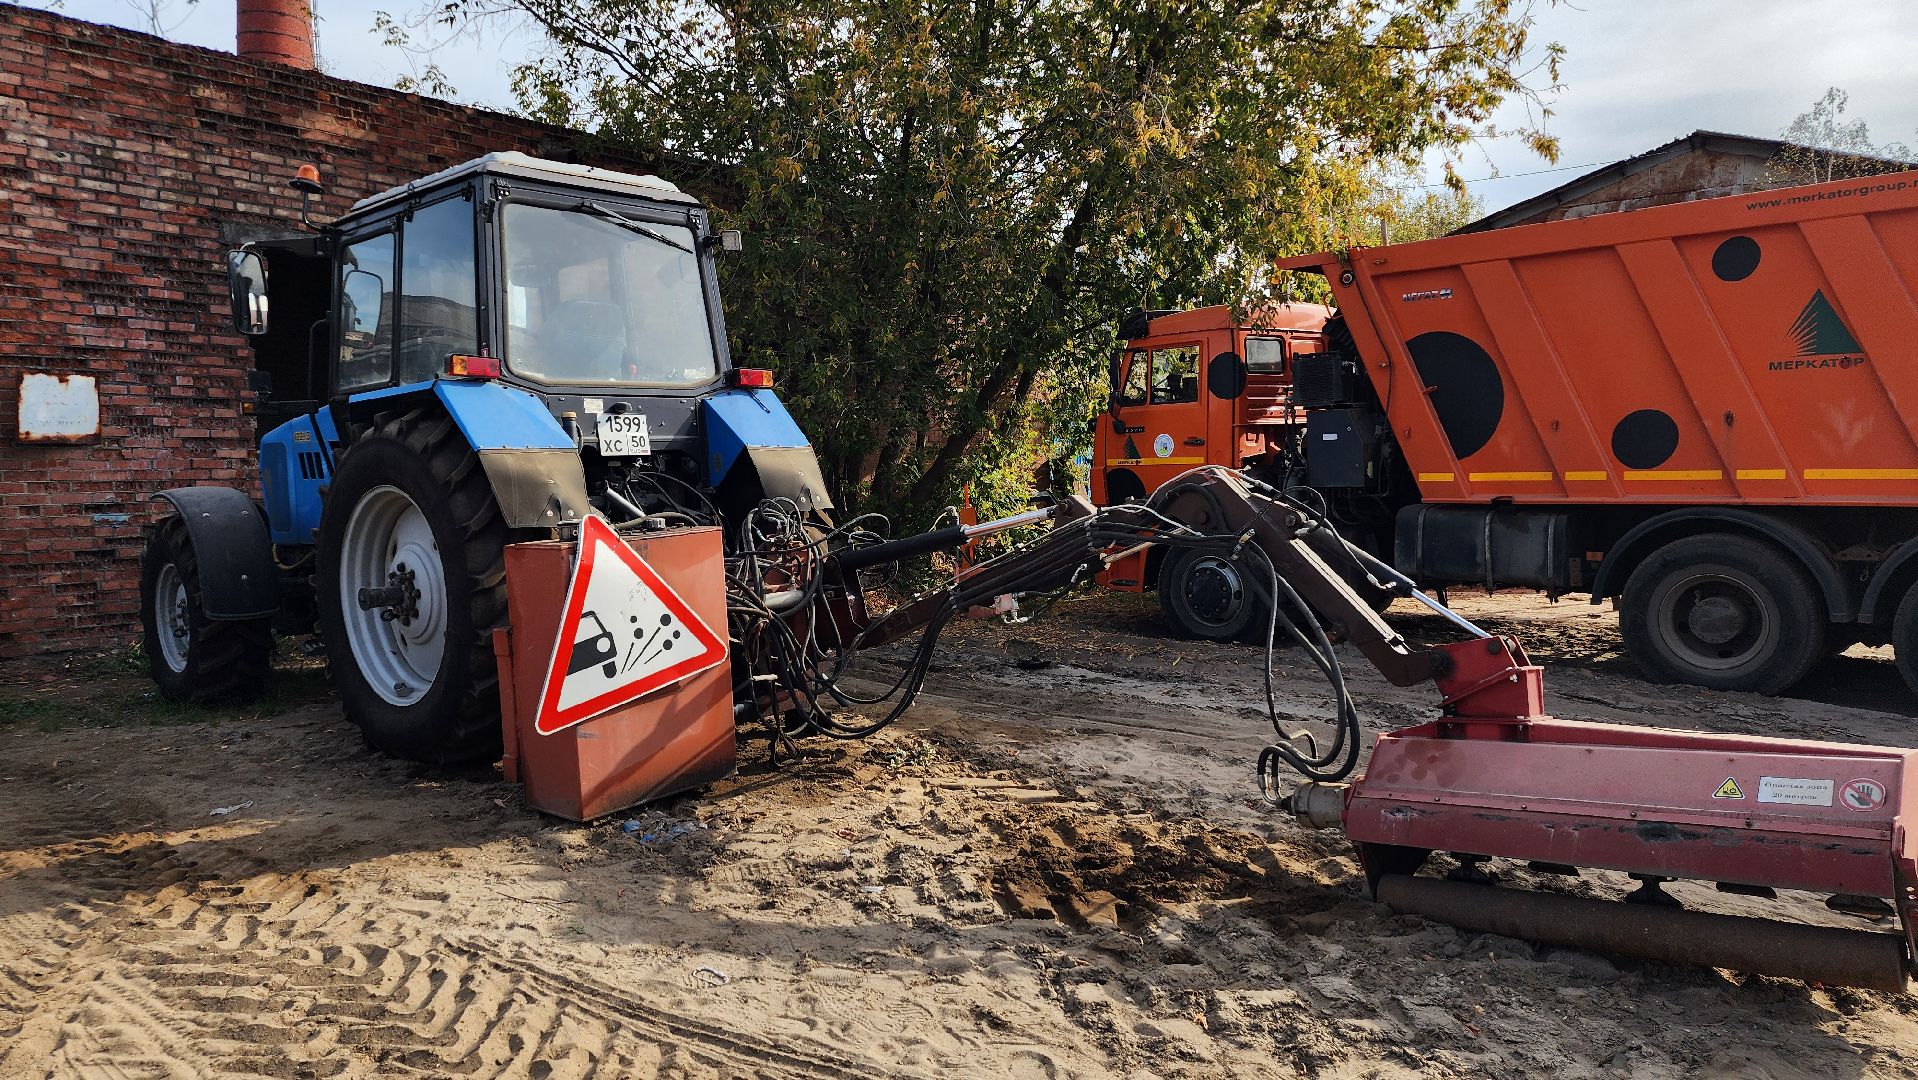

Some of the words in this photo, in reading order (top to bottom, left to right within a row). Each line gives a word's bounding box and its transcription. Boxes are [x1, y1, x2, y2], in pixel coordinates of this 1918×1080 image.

[1768, 357, 1865, 371] МЕРКАТОР
[606, 415, 641, 433] 1599
[631, 435, 646, 448] 50
